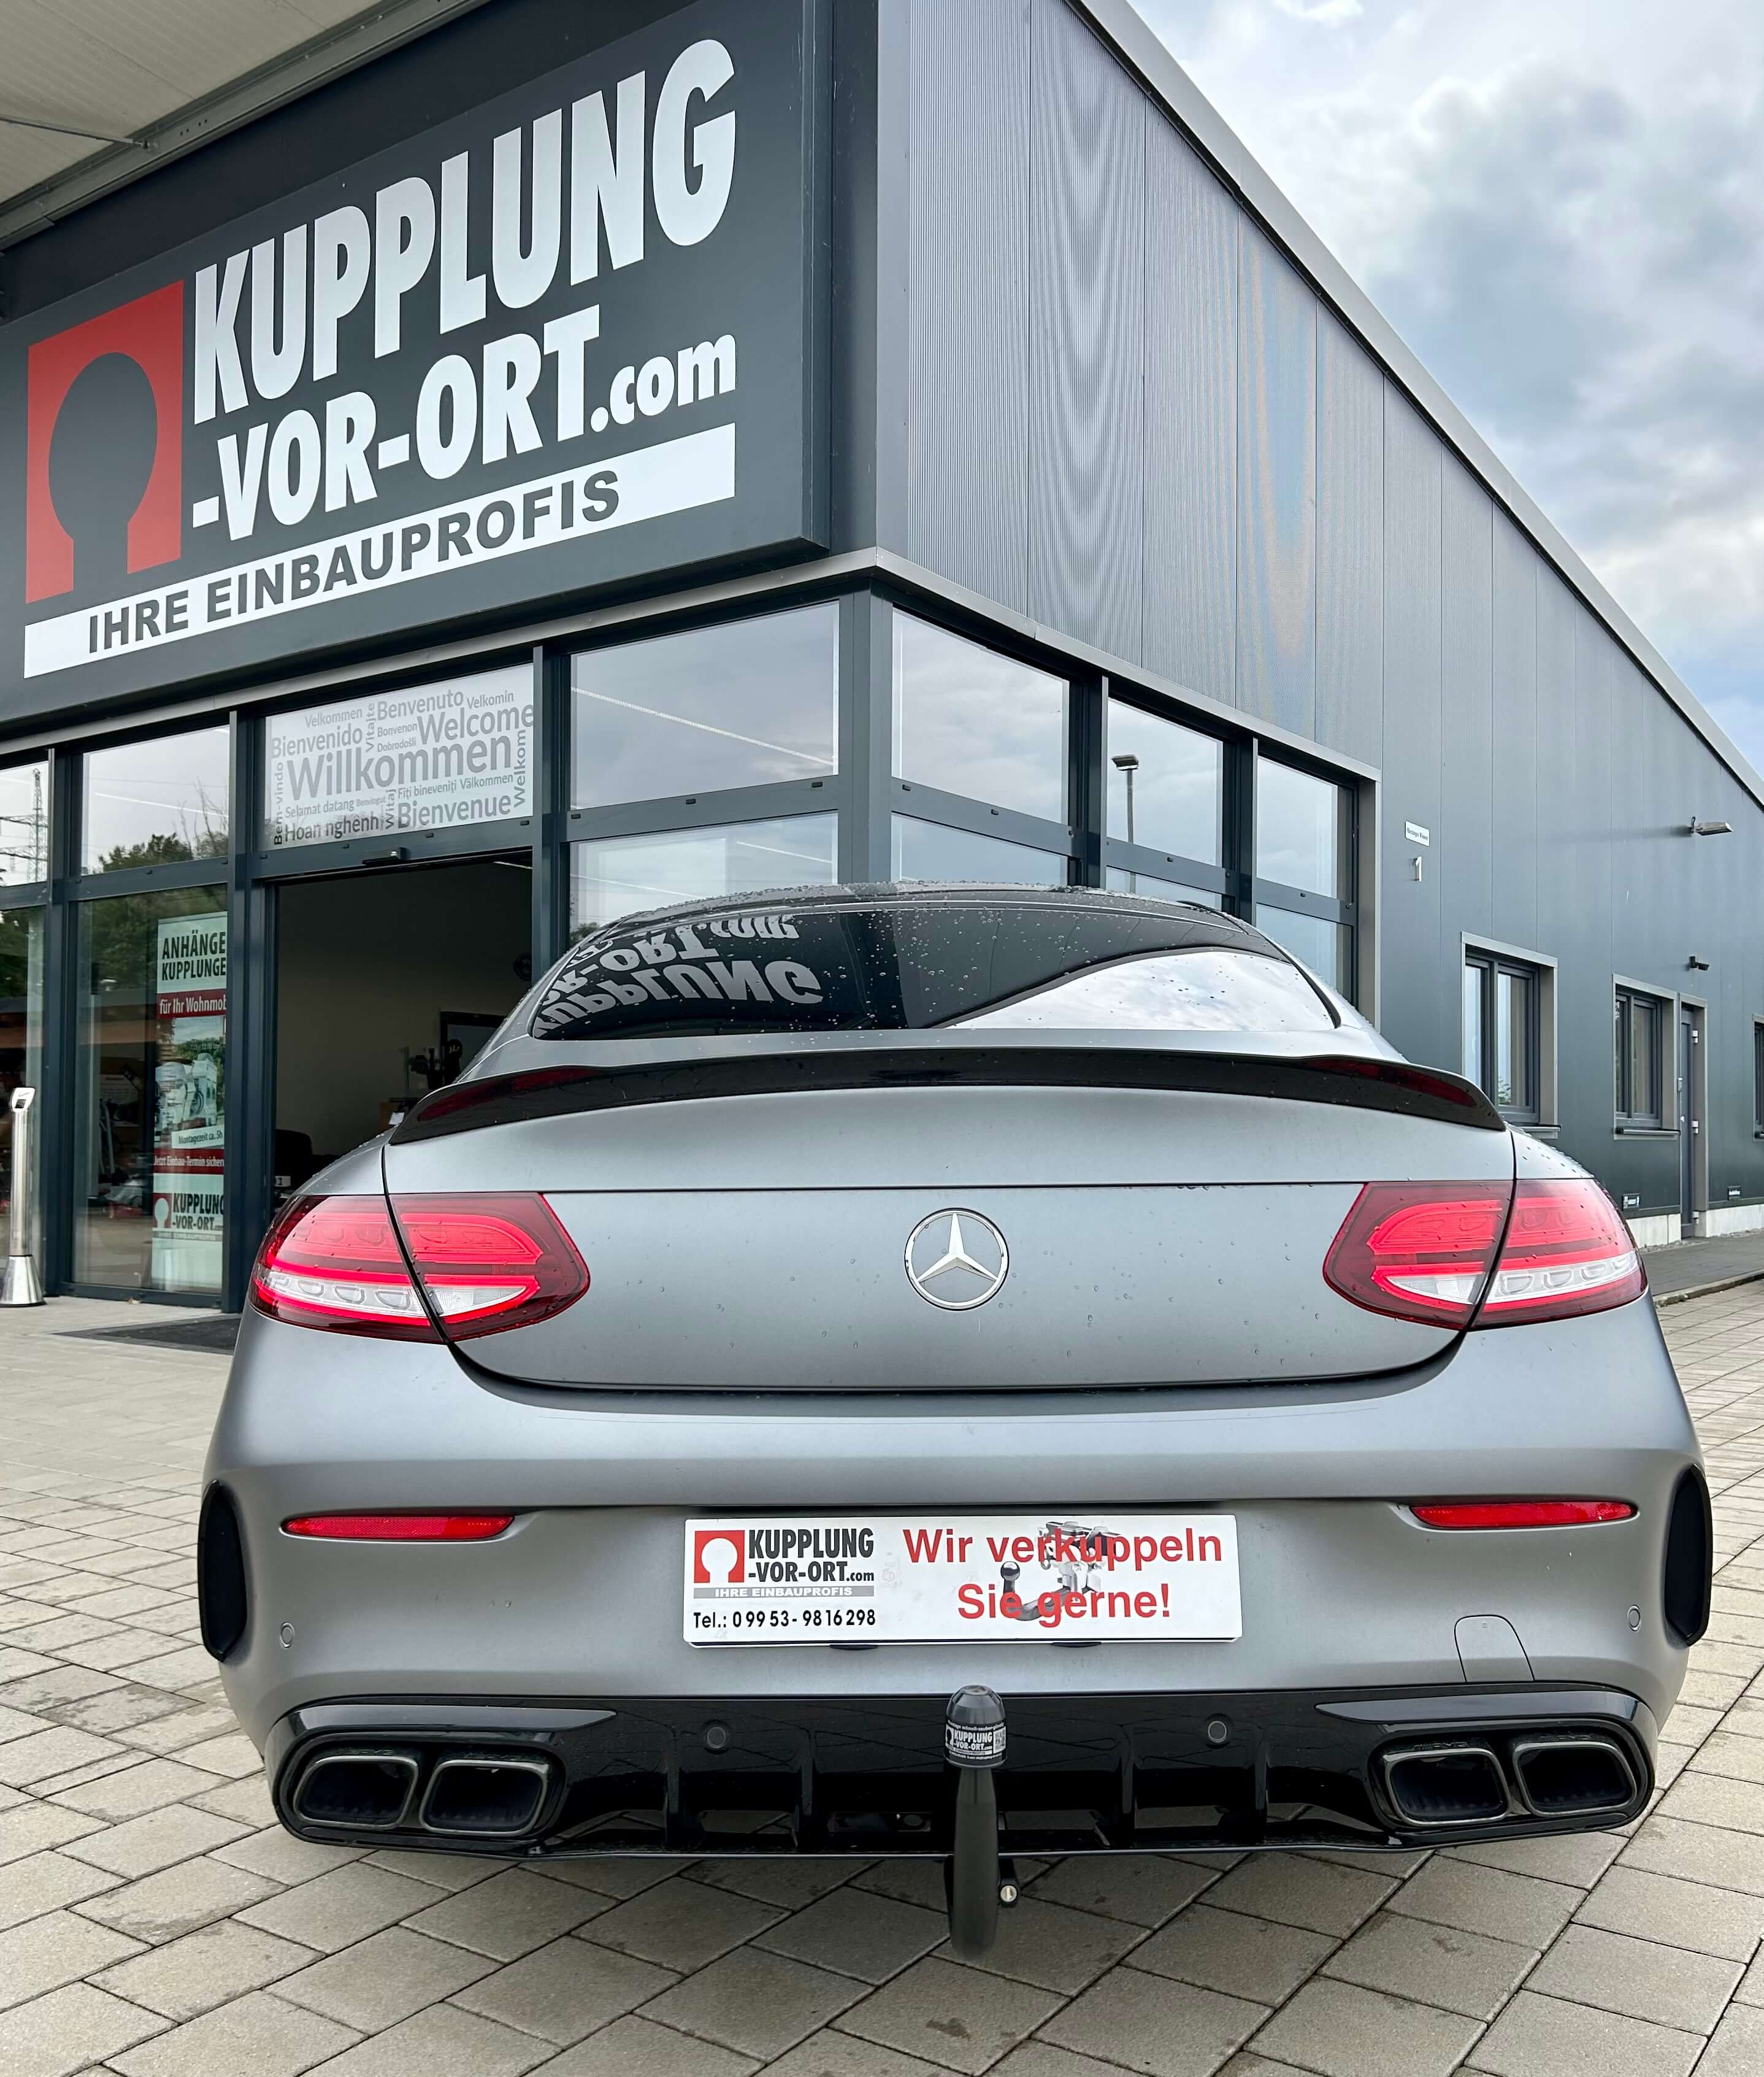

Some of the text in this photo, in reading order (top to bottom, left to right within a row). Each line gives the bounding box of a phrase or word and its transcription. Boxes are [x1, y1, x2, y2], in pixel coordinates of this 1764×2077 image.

[194, 38, 736, 425] KUPPLUNG
[193, 304, 736, 541] -VOR-ORT.com
[88, 470, 620, 654] IHRE EINBAUPROFIS
[377, 689, 464, 721] Benvenuto
[466, 689, 514, 710] Velkomin
[305, 707, 363, 728] Velkommen
[366, 702, 376, 753] Vitajte
[377, 723, 417, 737] Bonvenon
[416, 704, 534, 745] Welcome
[271, 723, 363, 759] Bienvenido
[286, 735, 512, 801] Willkommen
[460, 774, 513, 790] Välkommen
[514, 729, 526, 808] Welkom
[274, 762, 283, 846] Bem-vindo
[285, 800, 355, 819] Selamat datang
[386, 789, 396, 830] Witaj
[398, 794, 511, 829] Bienvenue
[285, 822, 321, 842] Hoan
[326, 812, 379, 839] nghênh
[1415, 856, 1422, 882] 1
[159, 999, 171, 1015] für
[173, 997, 185, 1013] Ihr
[748, 1527, 875, 1559] KUPPLUNG
[902, 1527, 1222, 1572] Wir verkuppeln
[748, 1561, 875, 1583] -VOR-ORT.com
[715, 1587, 853, 1598] IHRE EINBAUPROFIS
[957, 1583, 1170, 1628] Sie gerne!
[694, 1611, 727, 1629] Tel.:
[954, 1729, 992, 1743] KUPPLUNG
